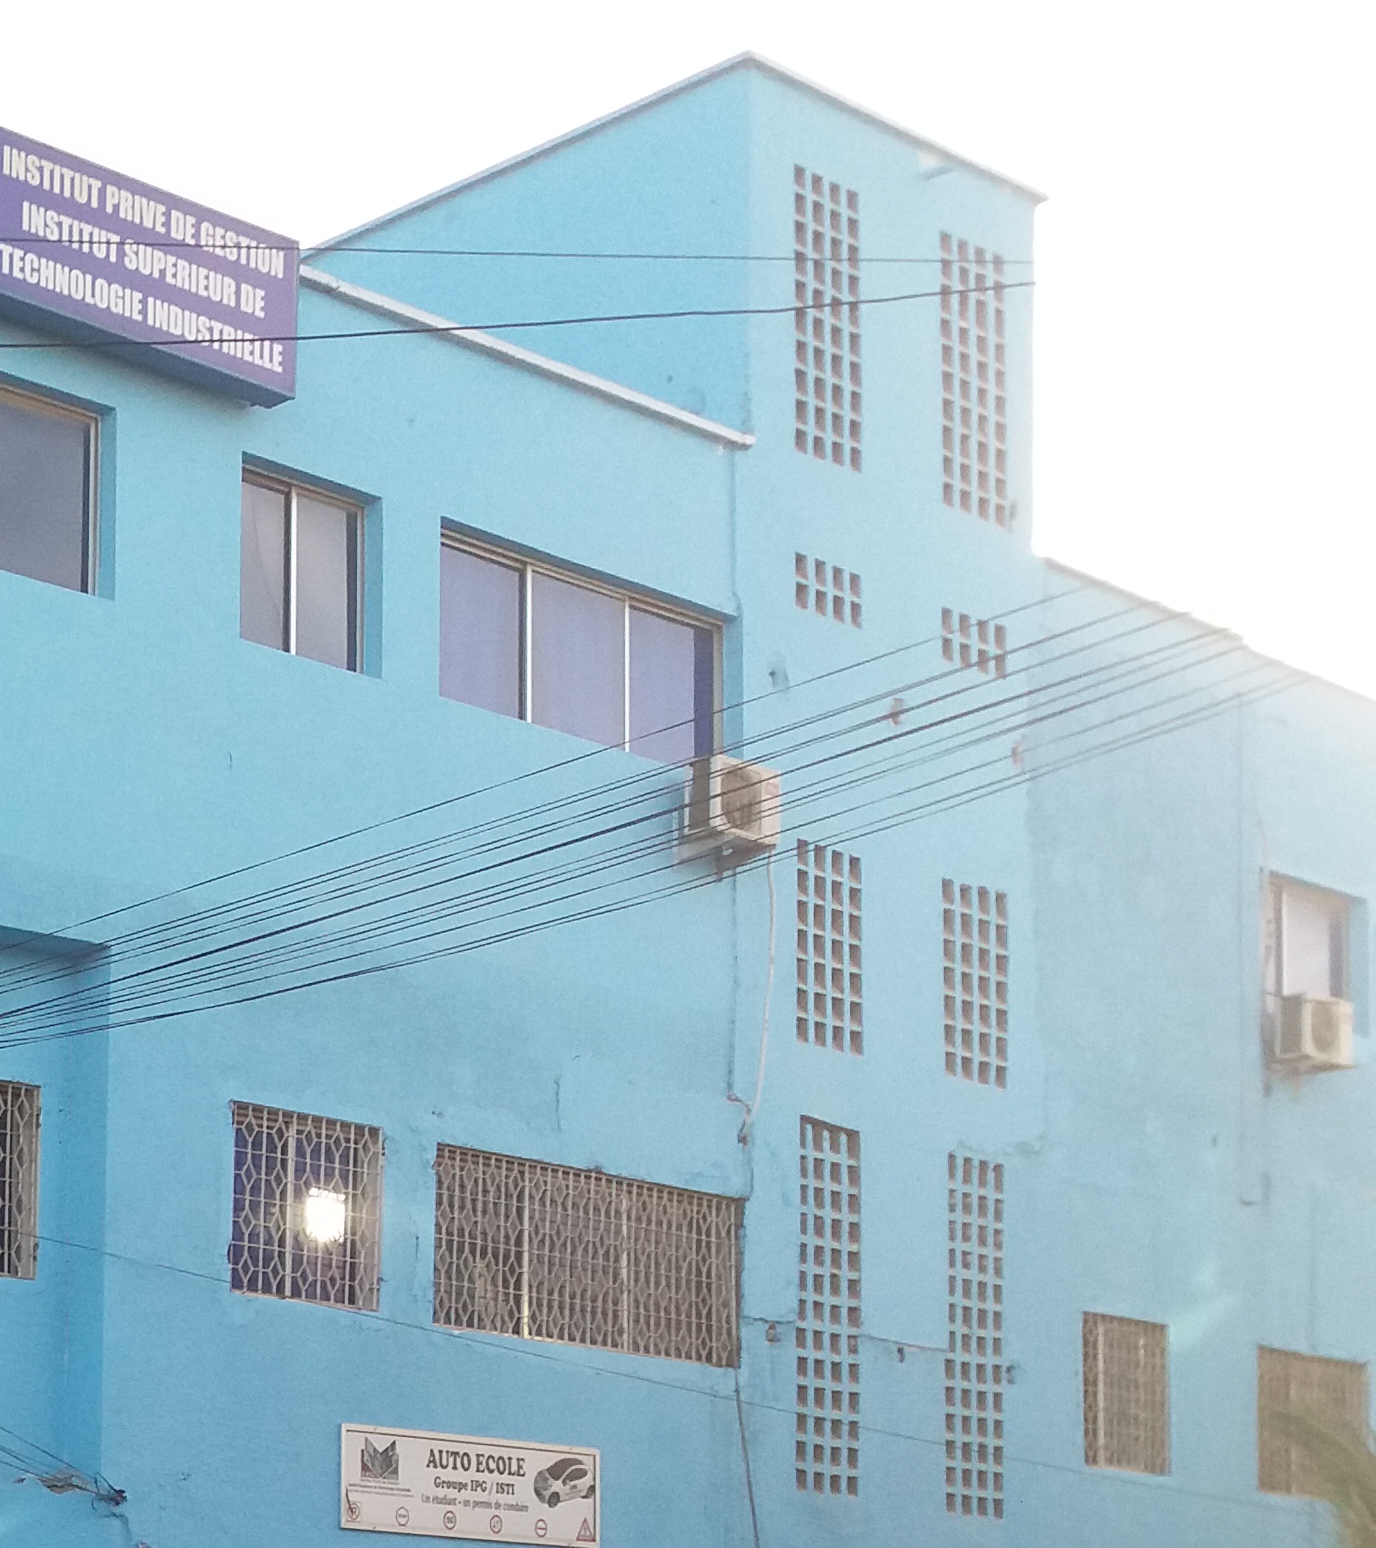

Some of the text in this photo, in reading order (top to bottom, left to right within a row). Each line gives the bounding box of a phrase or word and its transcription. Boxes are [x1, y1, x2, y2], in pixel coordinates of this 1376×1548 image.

[2, 144, 286, 280] INSTITUT PRIVE DE GESTION
[21, 201, 119, 263] INSTITUT
[123, 238, 236, 309] SUPERIEUR
[240, 283, 266, 319] DE
[0, 243, 284, 373] TECHNOLOGIE INDUSTRIELLE
[425, 1448, 527, 1478] AUTO ECOLE
[433, 1476, 469, 1494] Groupe
[470, 1480, 488, 1493] IPG
[495, 1482, 516, 1496] ISTI
